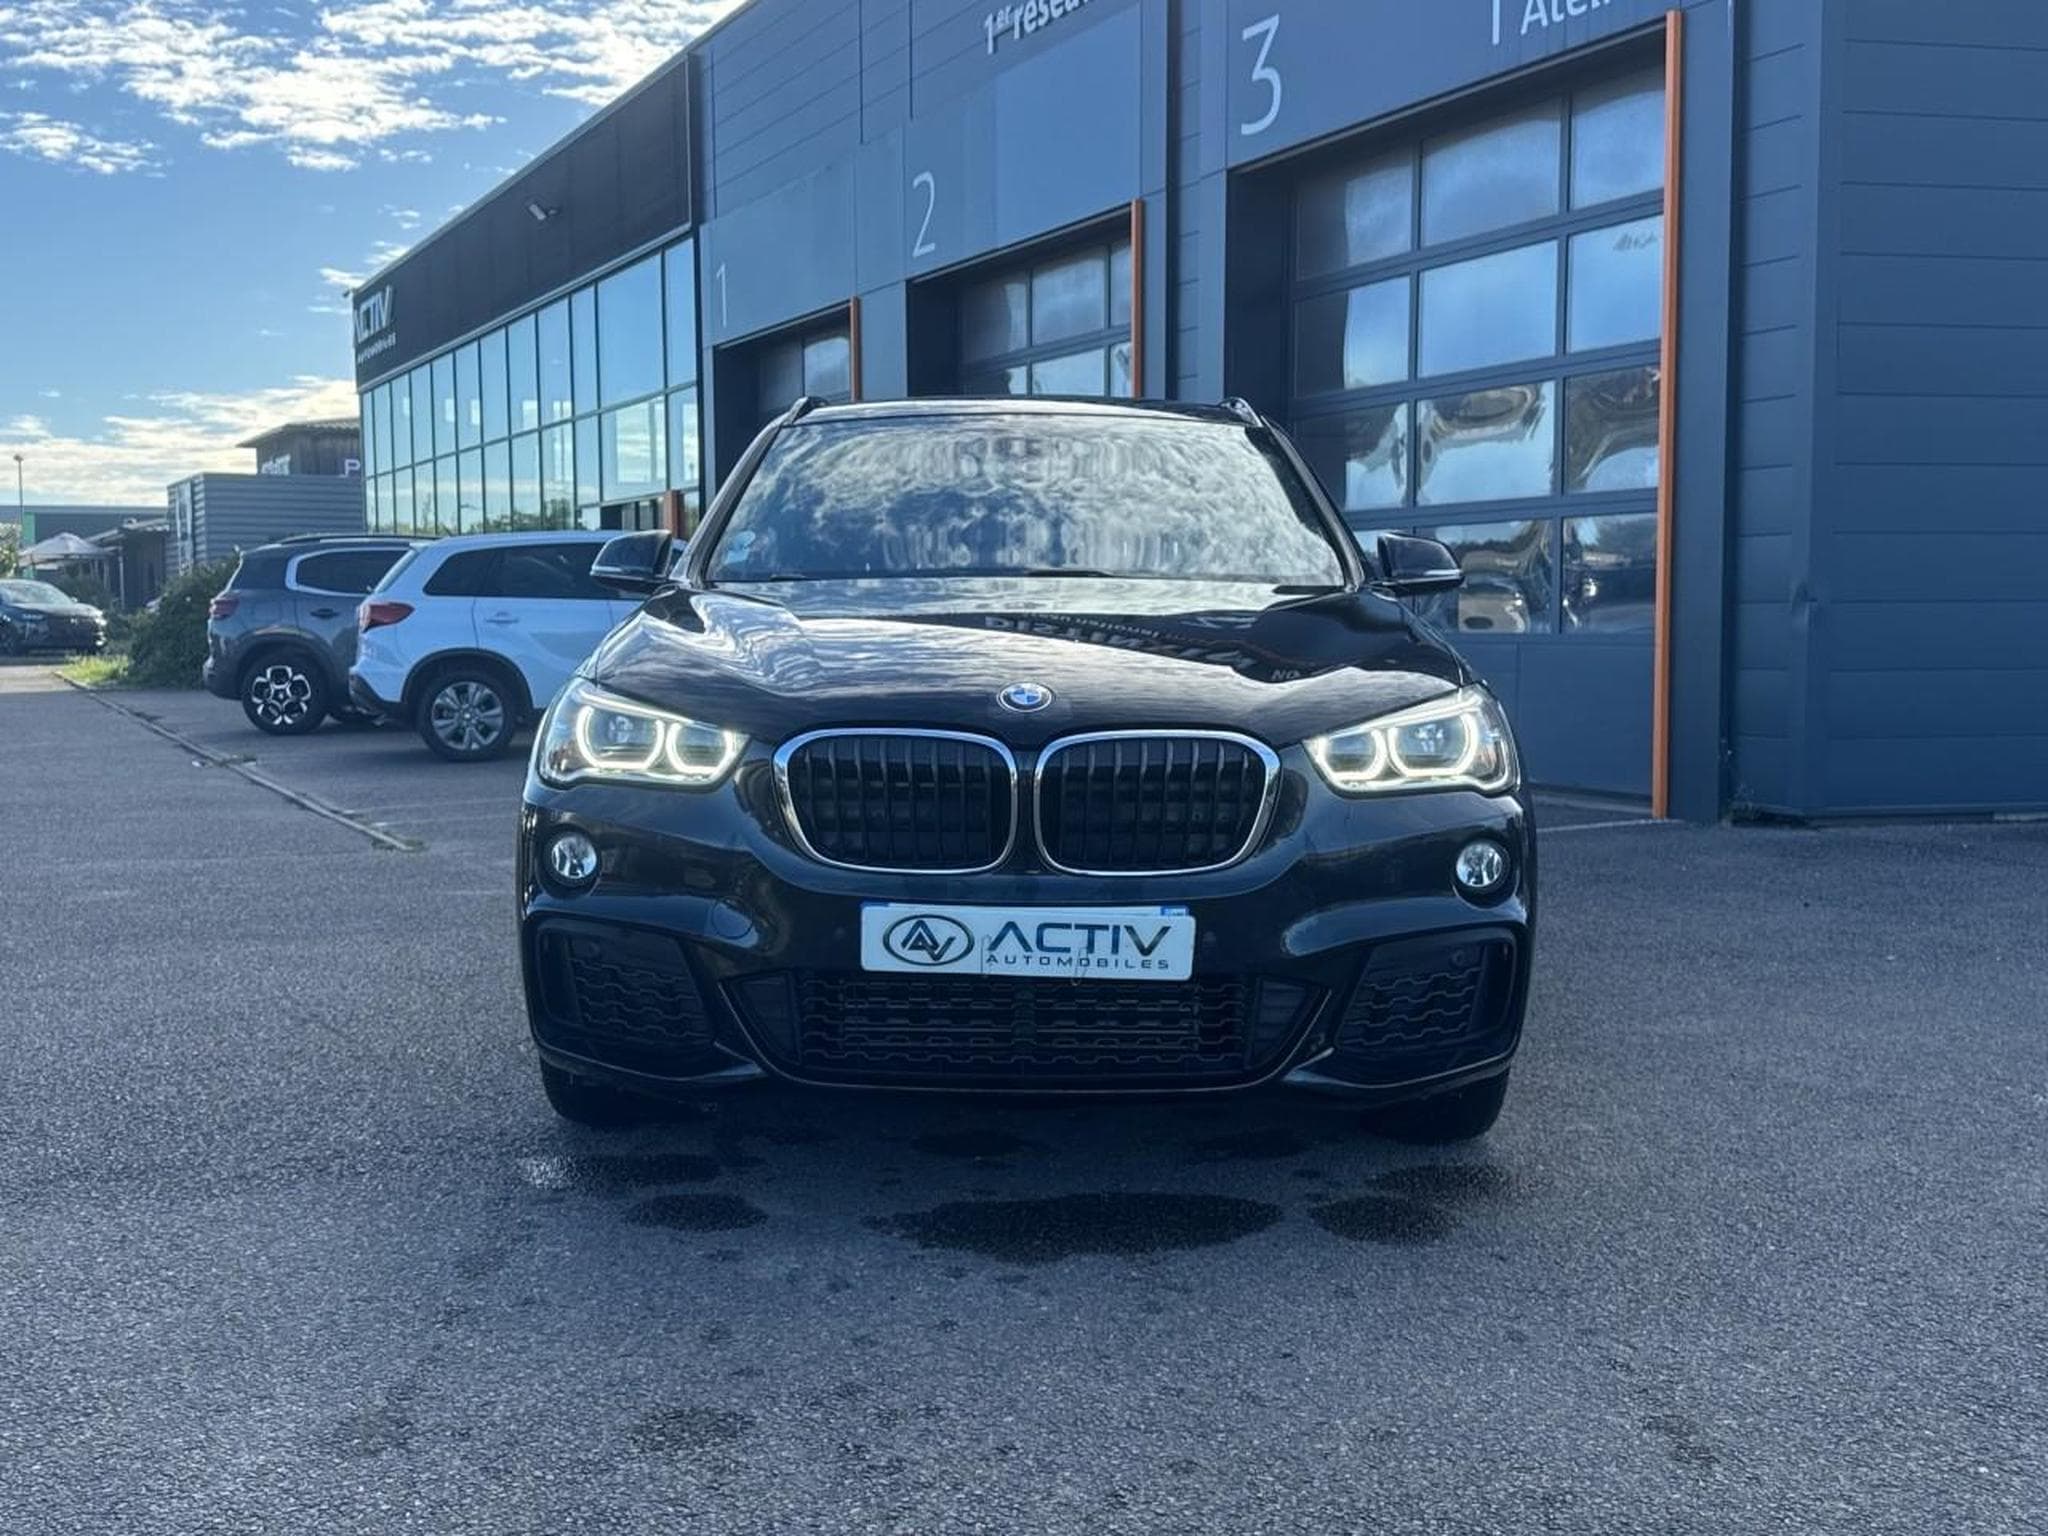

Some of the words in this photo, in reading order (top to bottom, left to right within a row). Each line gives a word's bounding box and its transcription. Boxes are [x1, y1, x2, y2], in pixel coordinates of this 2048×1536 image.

[1241, 13, 1281, 135] 3
[913, 171, 935, 258] 2
[716, 263, 728, 328] 1
[986, 954, 1169, 969] AUTOMOBILES
[987, 920, 1171, 956] ACTIV
